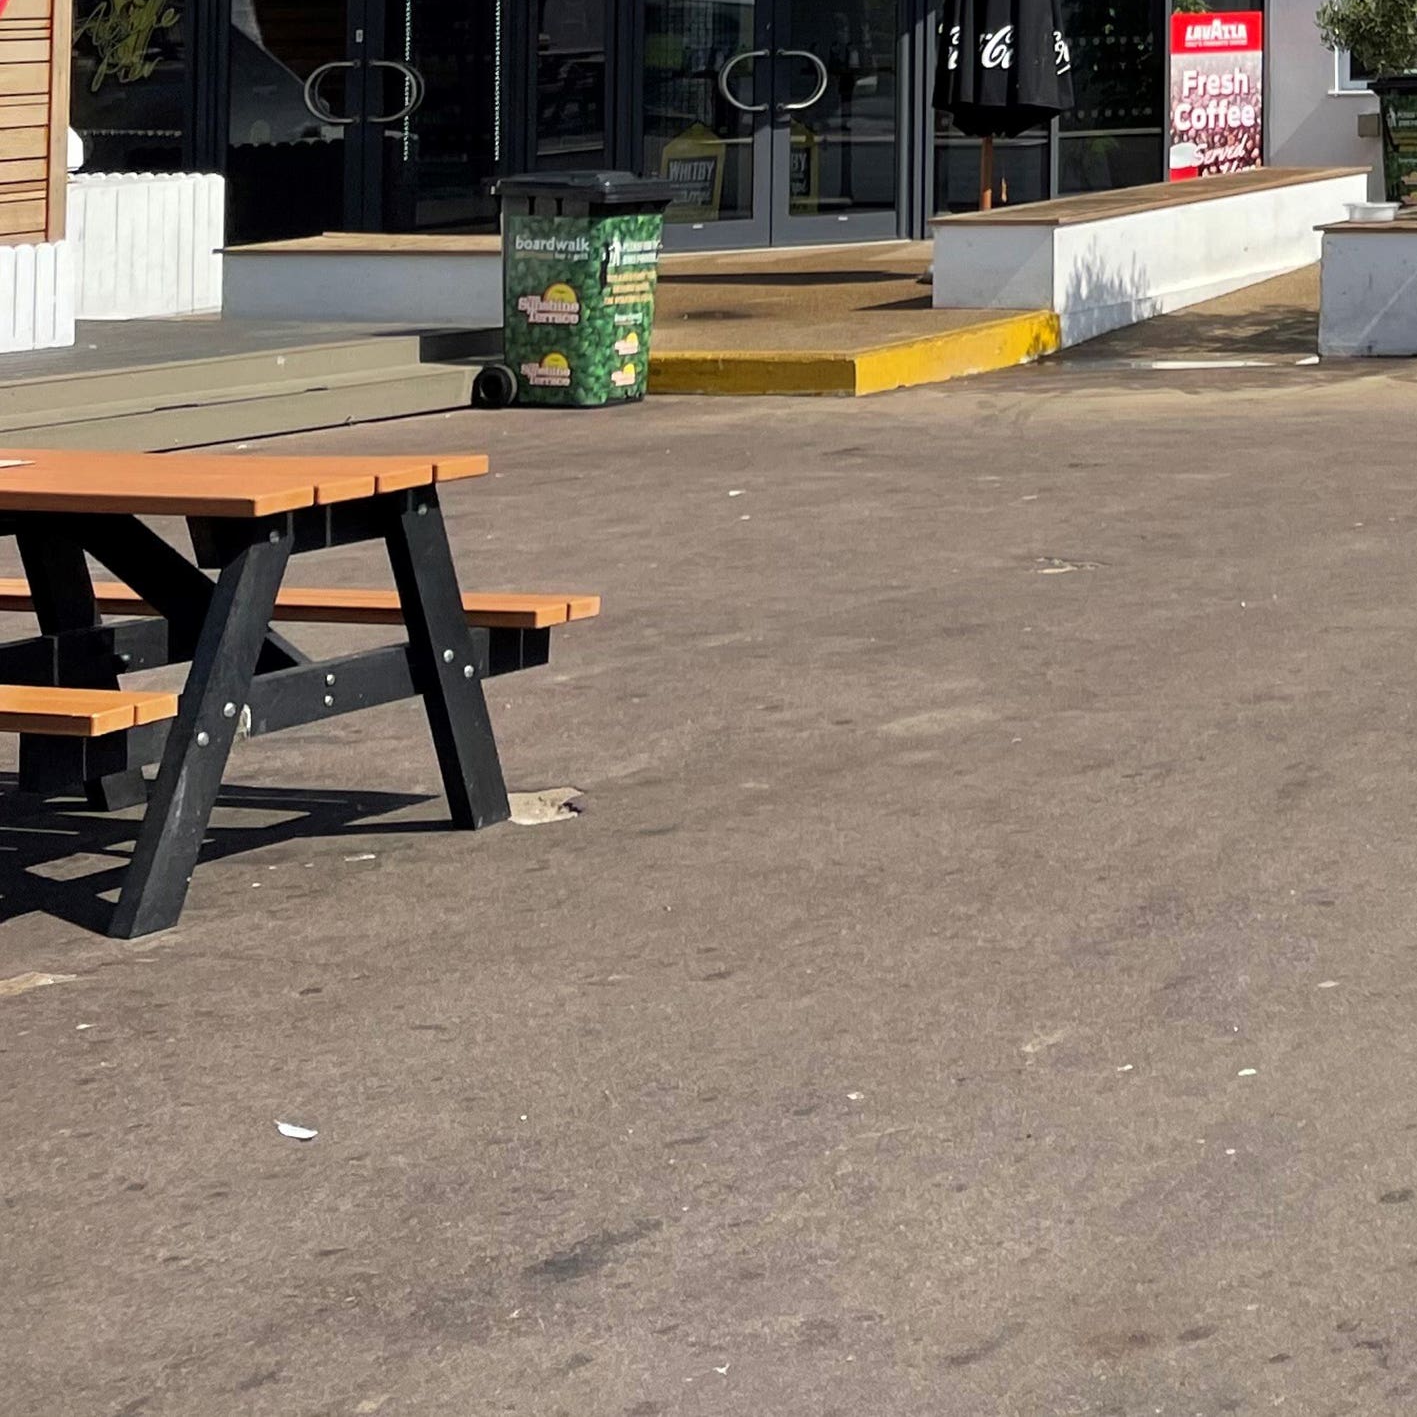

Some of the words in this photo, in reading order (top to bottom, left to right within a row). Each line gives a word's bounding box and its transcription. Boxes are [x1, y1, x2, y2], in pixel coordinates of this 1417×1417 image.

[1185, 19, 1247, 41] LAVAZZA
[1182, 67, 1250, 98] Fresh
[1174, 99, 1256, 132] Coffee
[1193, 134, 1247, 166] Served
[670, 160, 715, 182] WHITBY
[515, 236, 590, 252] boardwalk
[518, 296, 580, 313] Sunshine
[528, 312, 580, 324] Terrace
